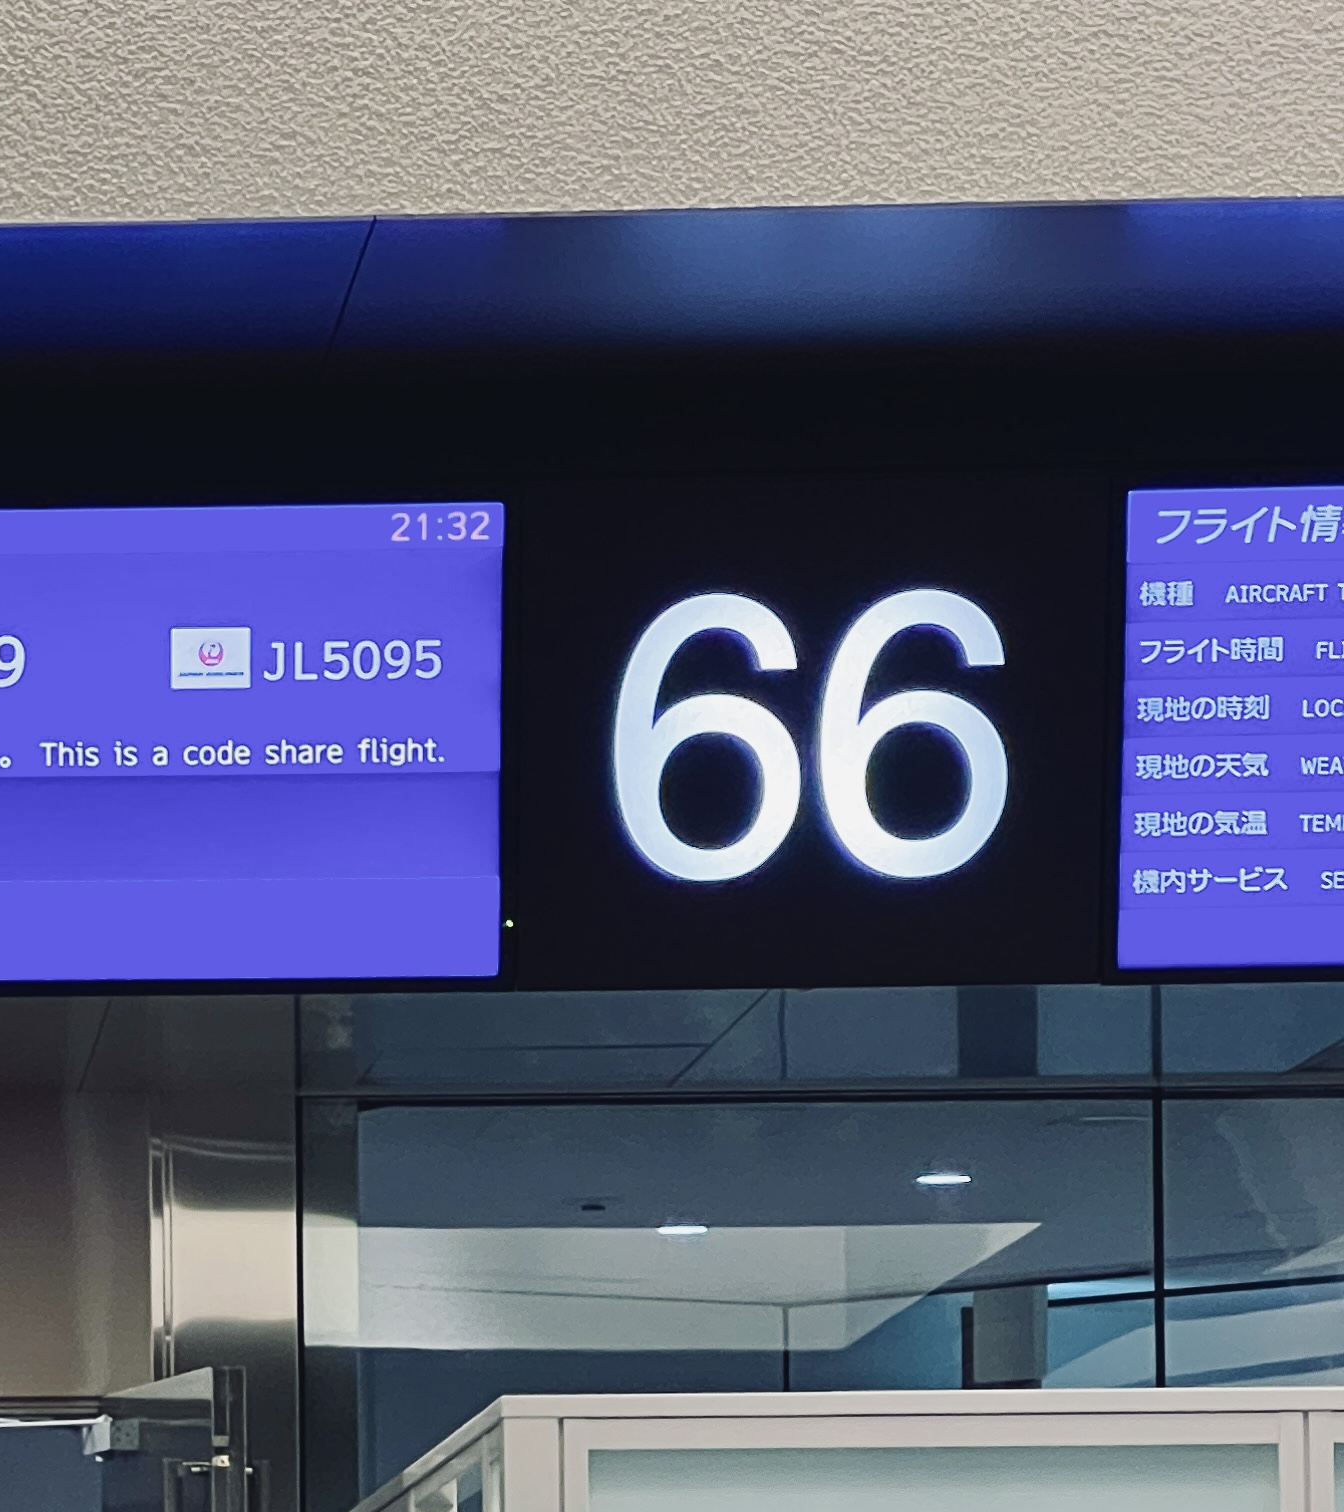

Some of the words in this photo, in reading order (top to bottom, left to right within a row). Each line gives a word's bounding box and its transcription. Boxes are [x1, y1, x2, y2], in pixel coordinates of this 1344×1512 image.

[390, 511, 490, 543] 21:32
[1154, 502, 1344, 546] フライト情
[1139, 580, 1195, 607] 機種
[1224, 582, 1329, 604] AIRCRAFT
[263, 639, 442, 682] JL5095
[1139, 636, 1285, 665] フライト時間
[1136, 694, 1271, 722] 現地の時刻
[612, 587, 1009, 883] 66
[38, 741, 100, 767] This
[113, 740, 139, 767] is
[152, 745, 169, 767] a
[183, 739, 251, 766] code
[265, 738, 344, 765] share
[357, 736, 445, 767] flight.
[1135, 752, 1270, 780] 現地の天気
[1133, 810, 1268, 838] 現地の気温
[1298, 813, 1344, 833] TEM
[1132, 865, 1289, 895] 機内サービス
